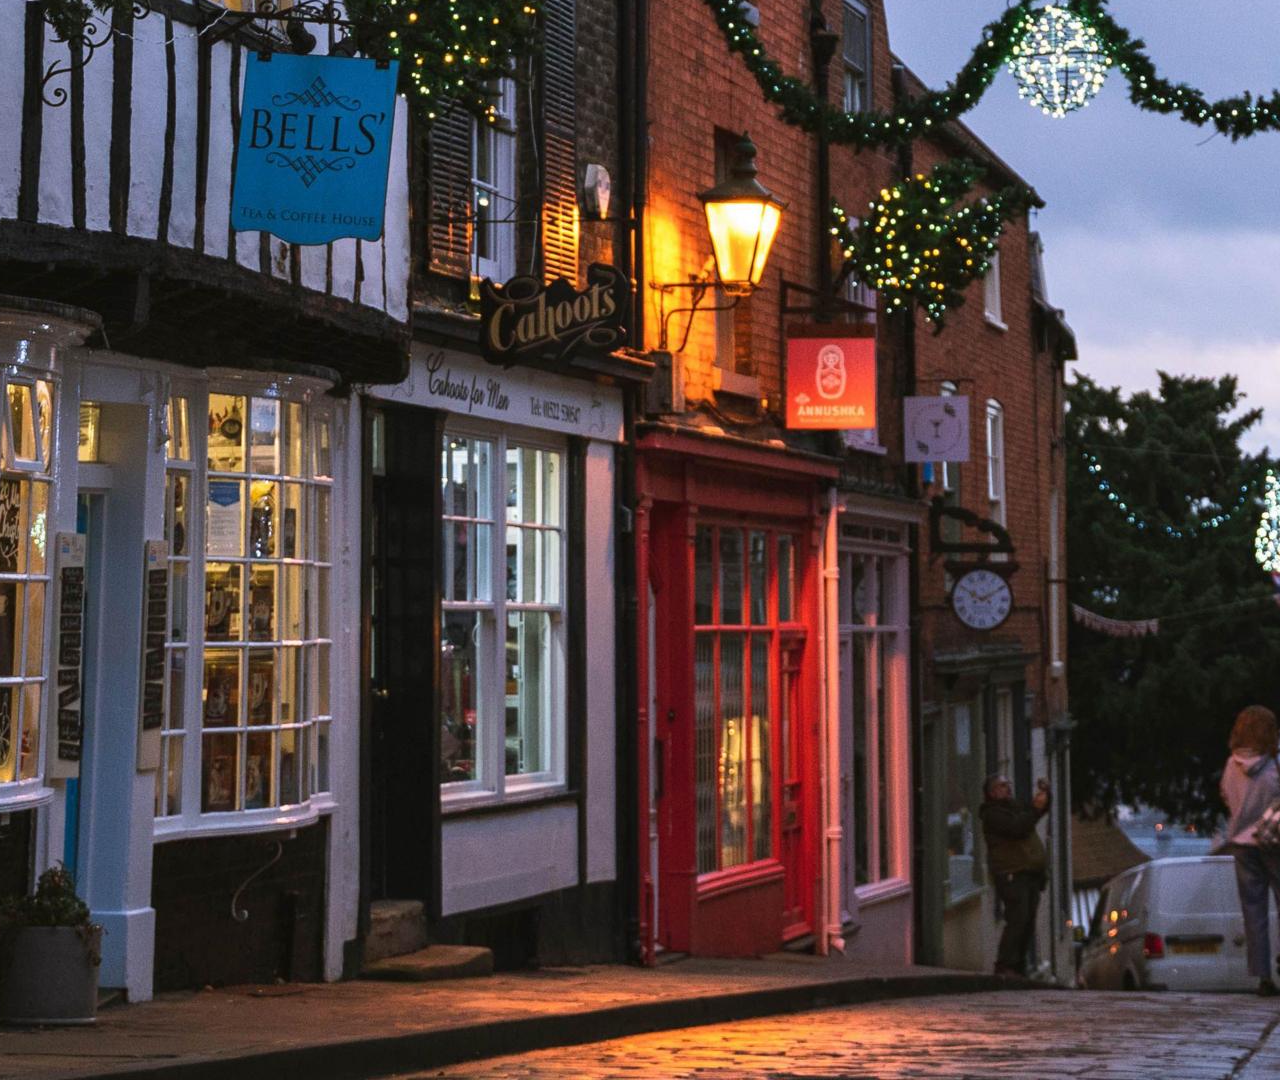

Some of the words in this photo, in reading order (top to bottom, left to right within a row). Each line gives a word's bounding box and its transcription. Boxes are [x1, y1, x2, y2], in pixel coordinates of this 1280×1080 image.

[249, 108, 385, 156] BELLS'
[267, 209, 277, 220] &
[490, 283, 616, 351] Cahoots
[427, 351, 469, 401] Cahoots
[469, 375, 485, 412] for
[487, 379, 509, 411] Men
[798, 405, 865, 417] ANNUSHKA
